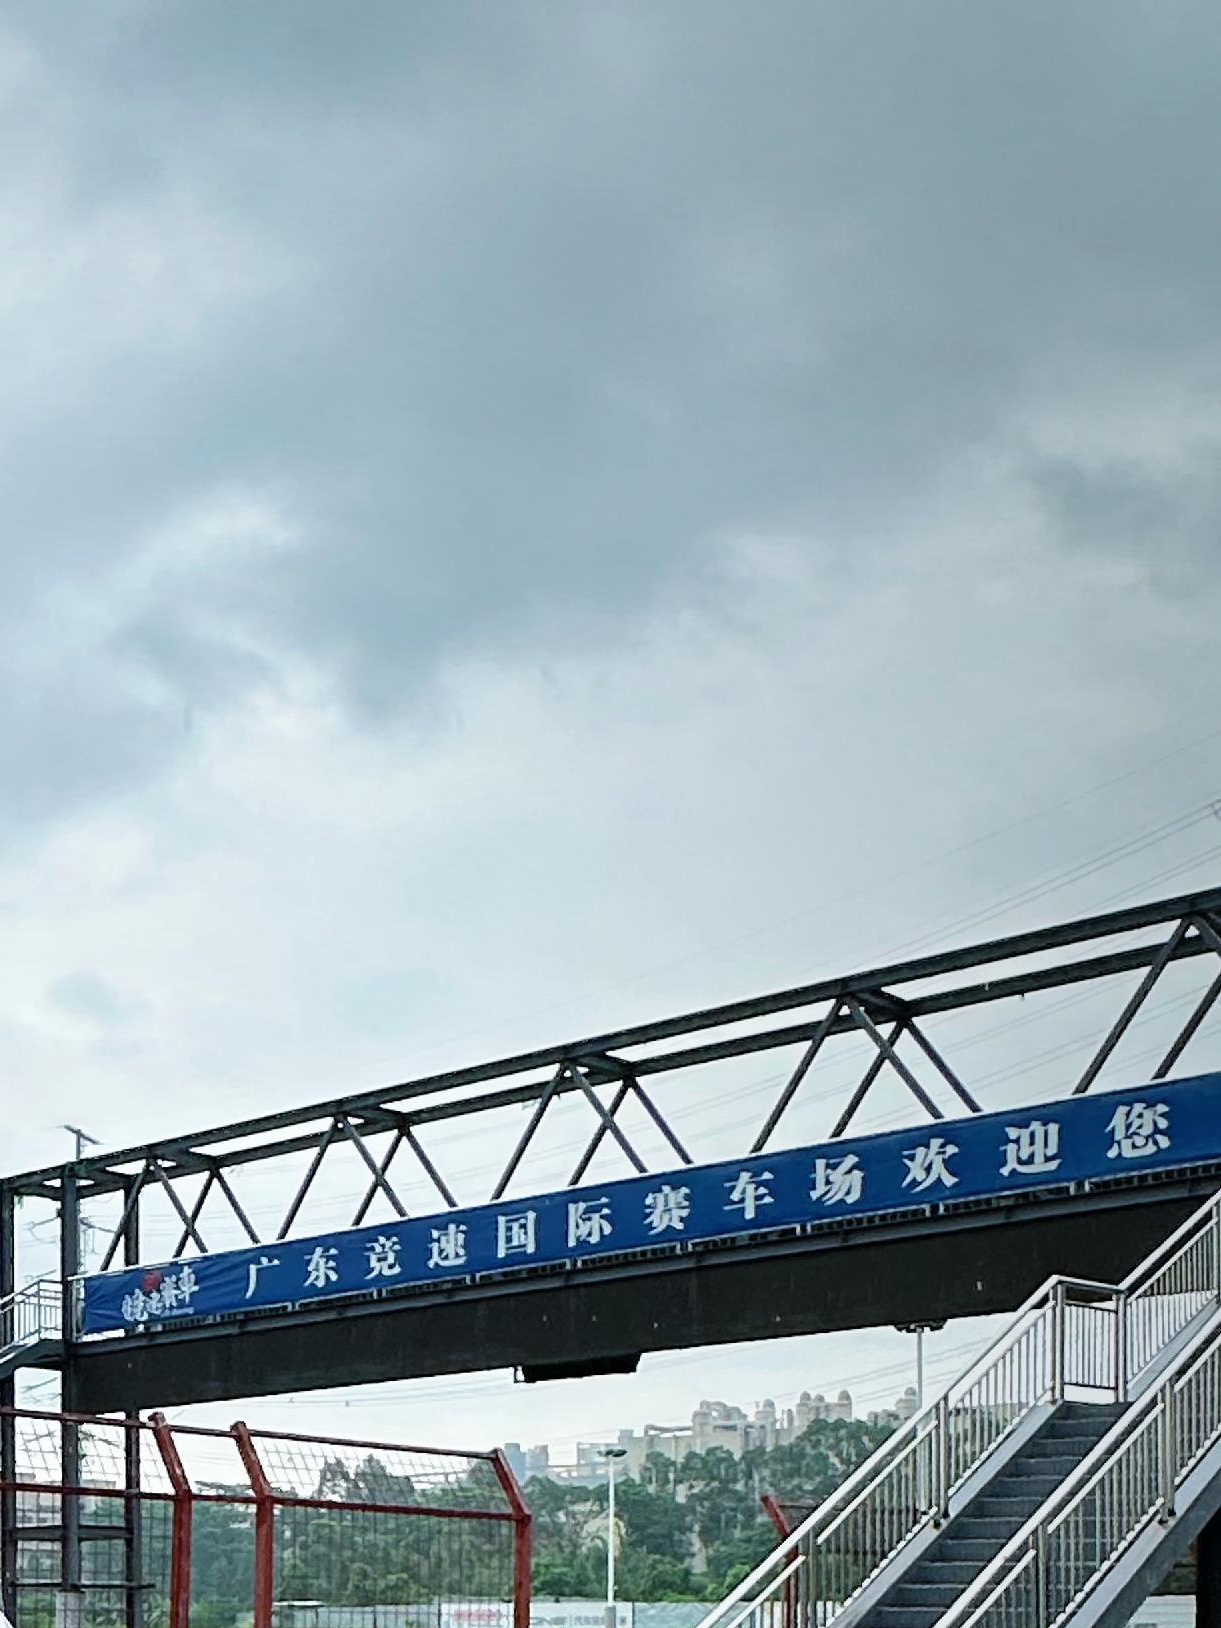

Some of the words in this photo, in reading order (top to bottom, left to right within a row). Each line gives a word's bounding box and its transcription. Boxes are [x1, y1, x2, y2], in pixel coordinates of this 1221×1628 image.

[245, 1102, 1171, 1298] 广东竞速国际赛车场欢迎您
